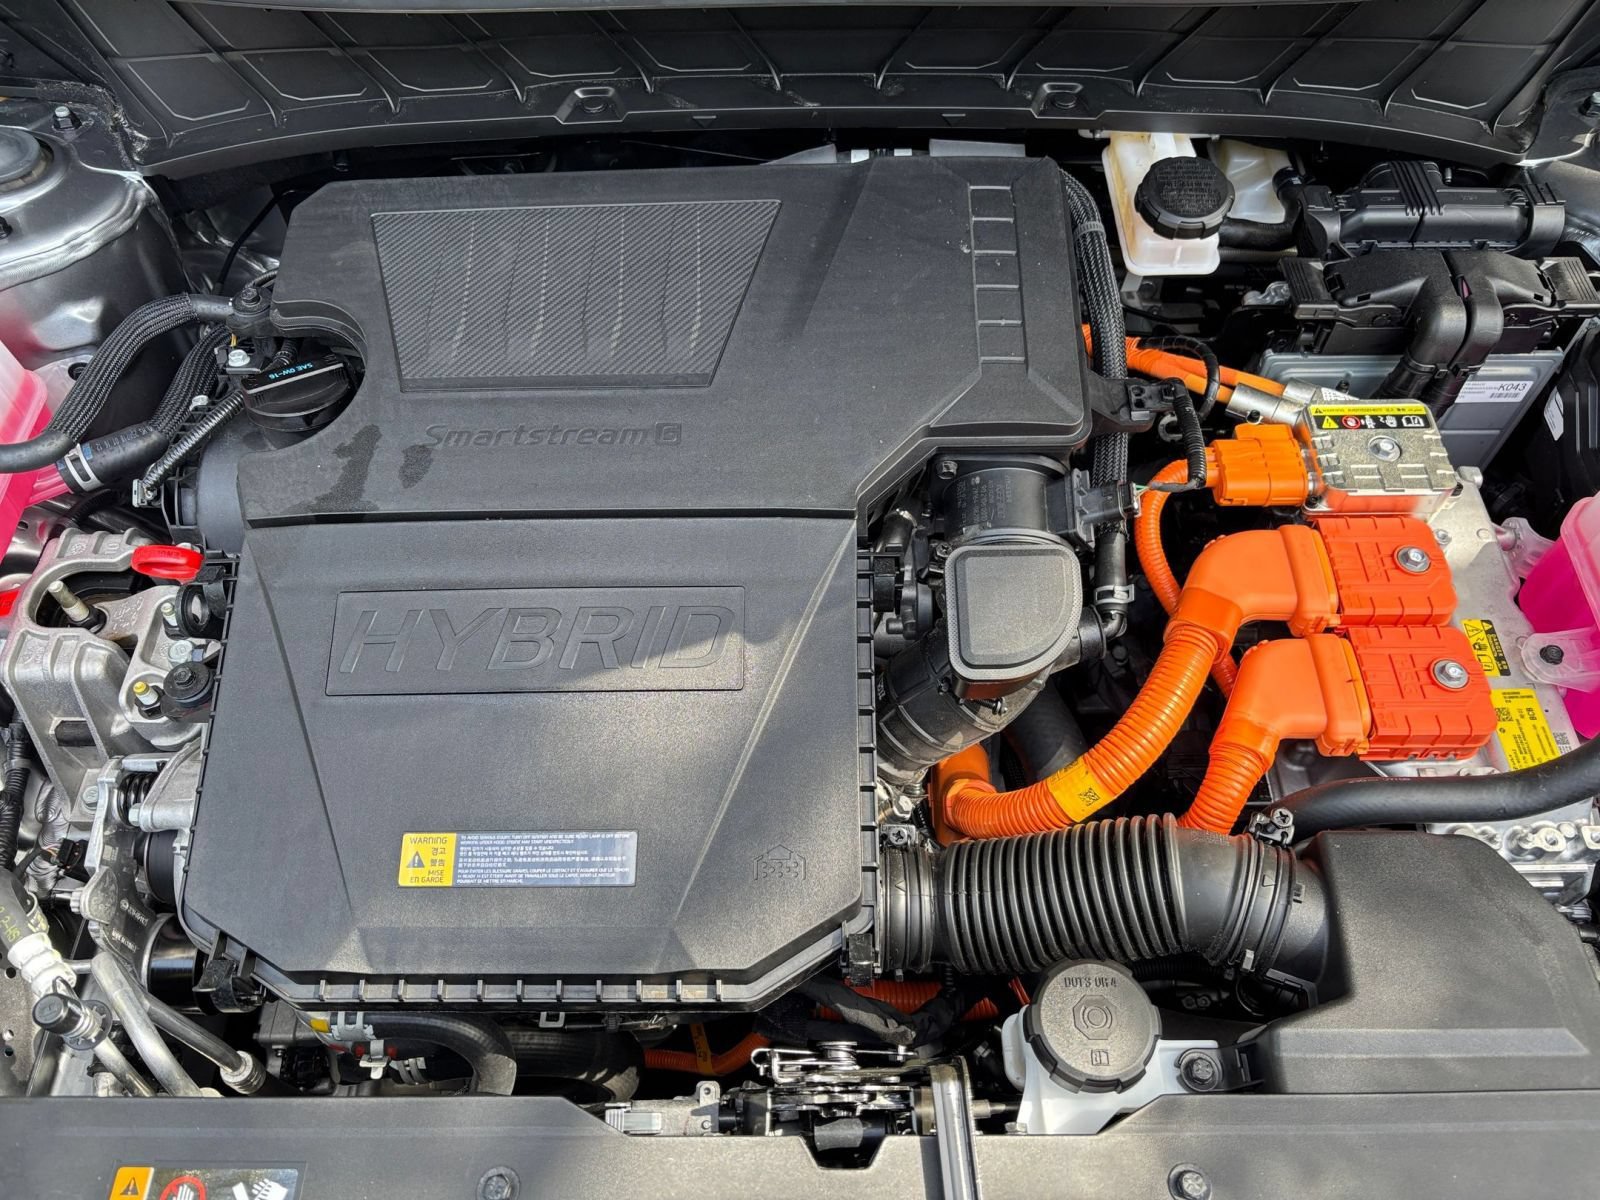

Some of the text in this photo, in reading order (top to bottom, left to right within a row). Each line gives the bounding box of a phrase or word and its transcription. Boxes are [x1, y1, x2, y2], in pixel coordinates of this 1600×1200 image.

[268, 363, 313, 379] SAE 0W-16
[1498, 383, 1527, 392] K043
[424, 424, 650, 447] Smartstream
[339, 605, 736, 674] HYBRID
[410, 836, 448, 844] WARNING
